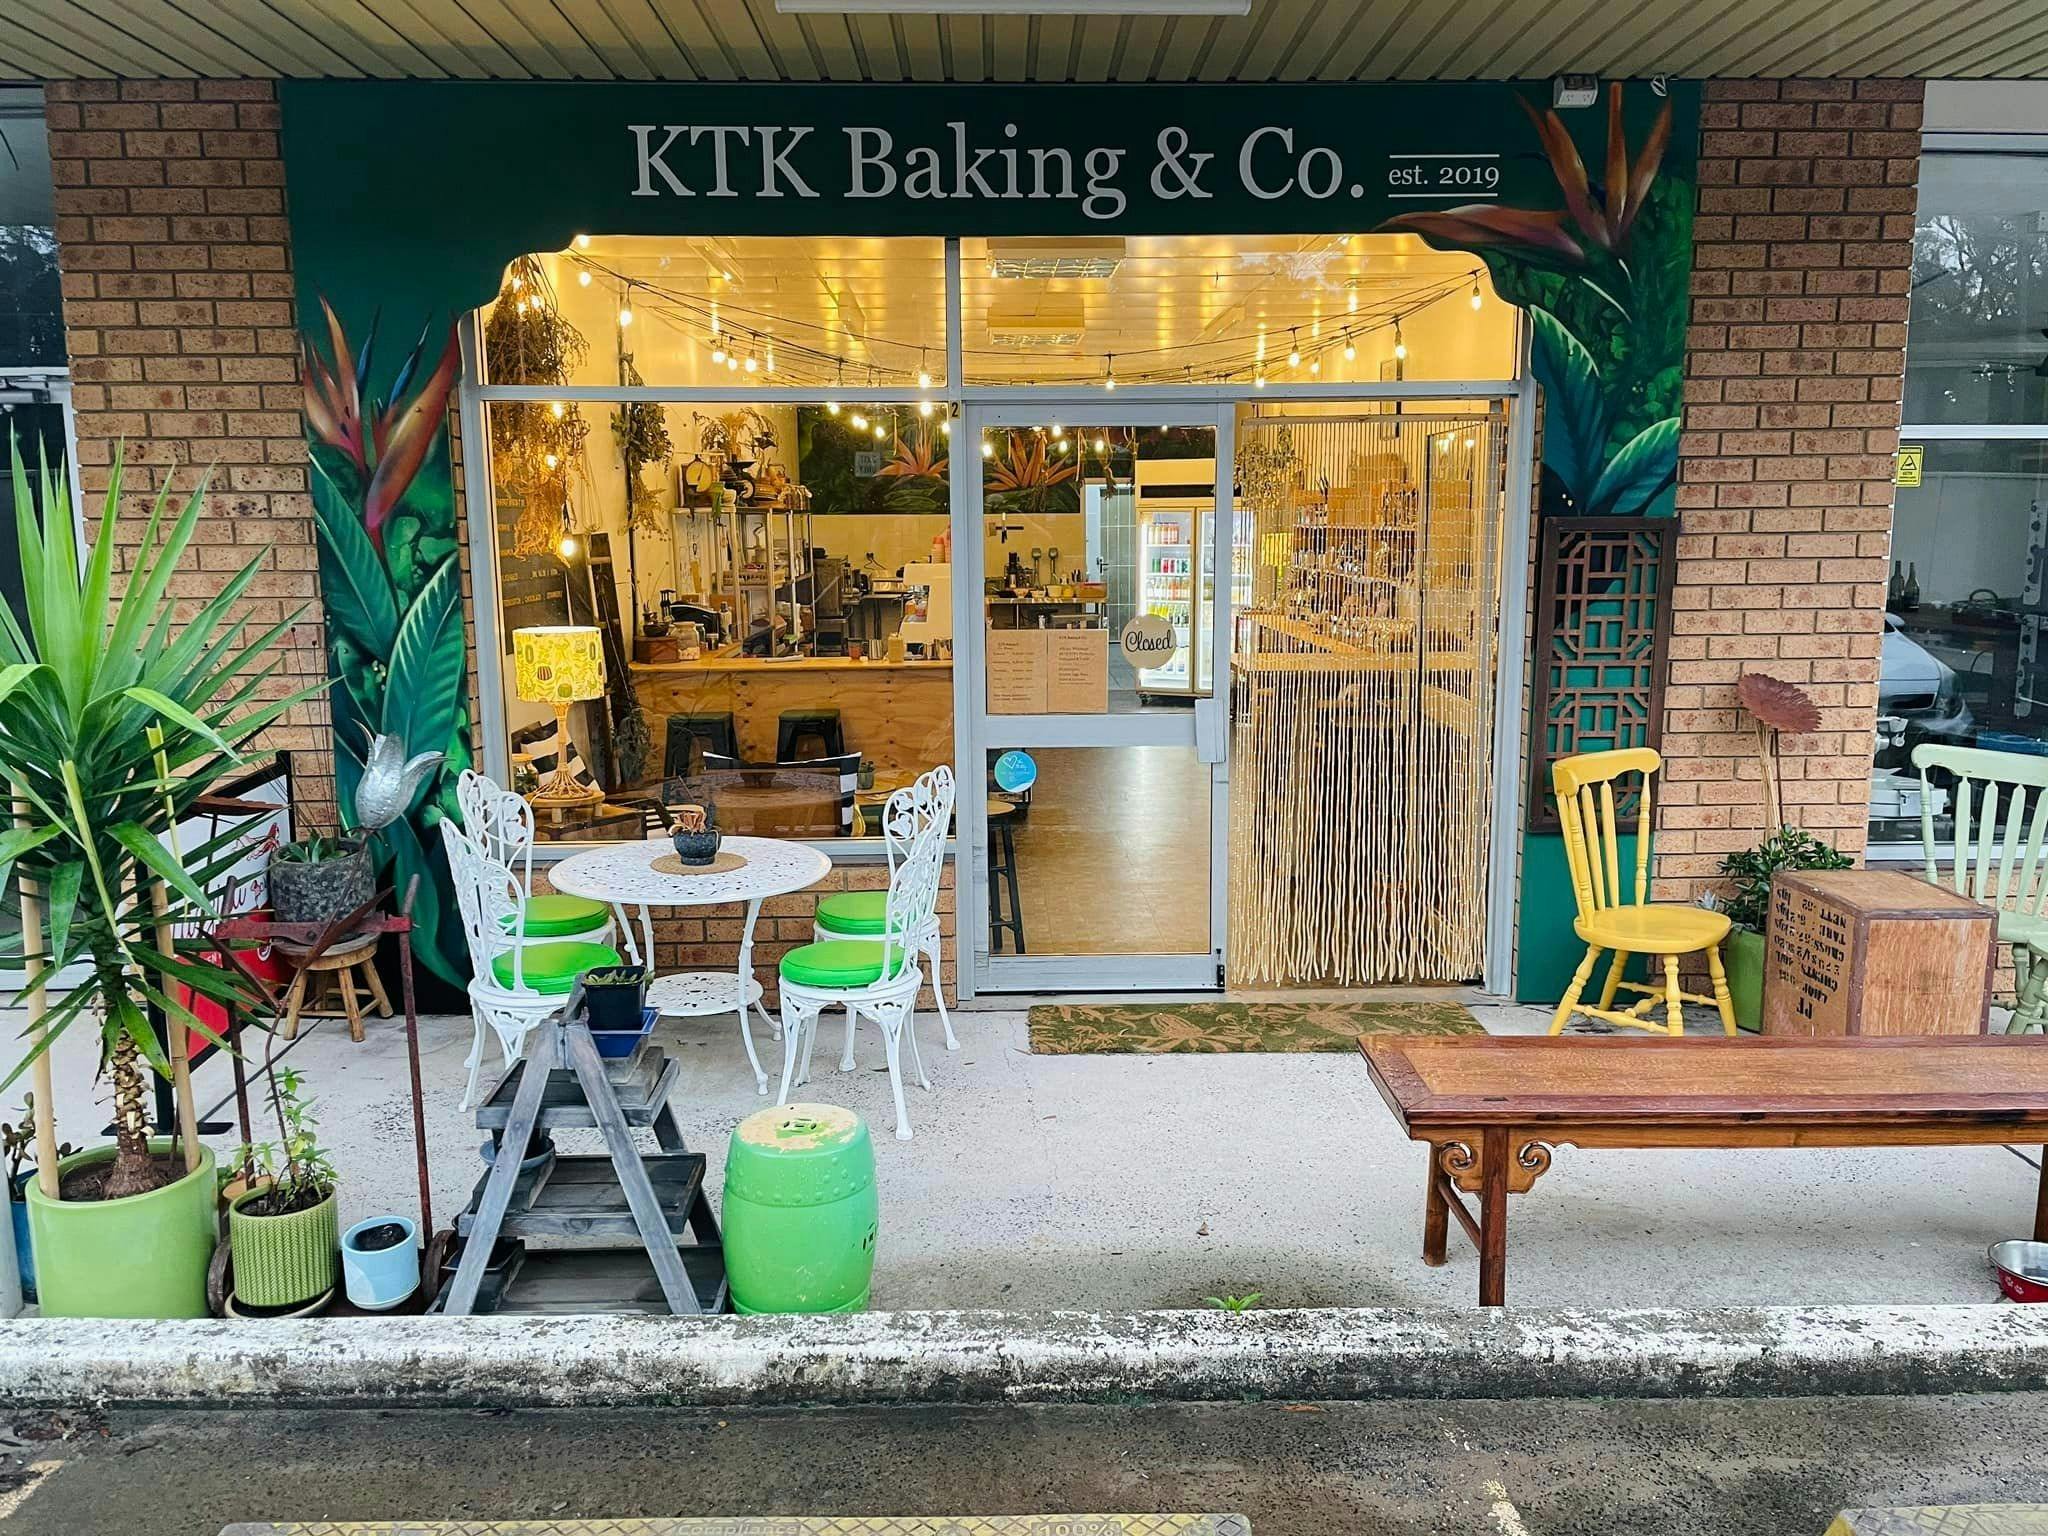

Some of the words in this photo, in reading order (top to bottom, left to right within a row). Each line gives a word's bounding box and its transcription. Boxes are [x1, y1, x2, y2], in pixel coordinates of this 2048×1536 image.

[628, 125, 820, 197] KTK
[842, 122, 1127, 219] Baking
[1150, 126, 1215, 200] &
[1239, 126, 1364, 199] Co.
[1388, 165, 1428, 185] est.
[1439, 166, 1500, 189] 2019
[951, 401, 959, 418] 2
[1125, 629, 1174, 653] Closed
